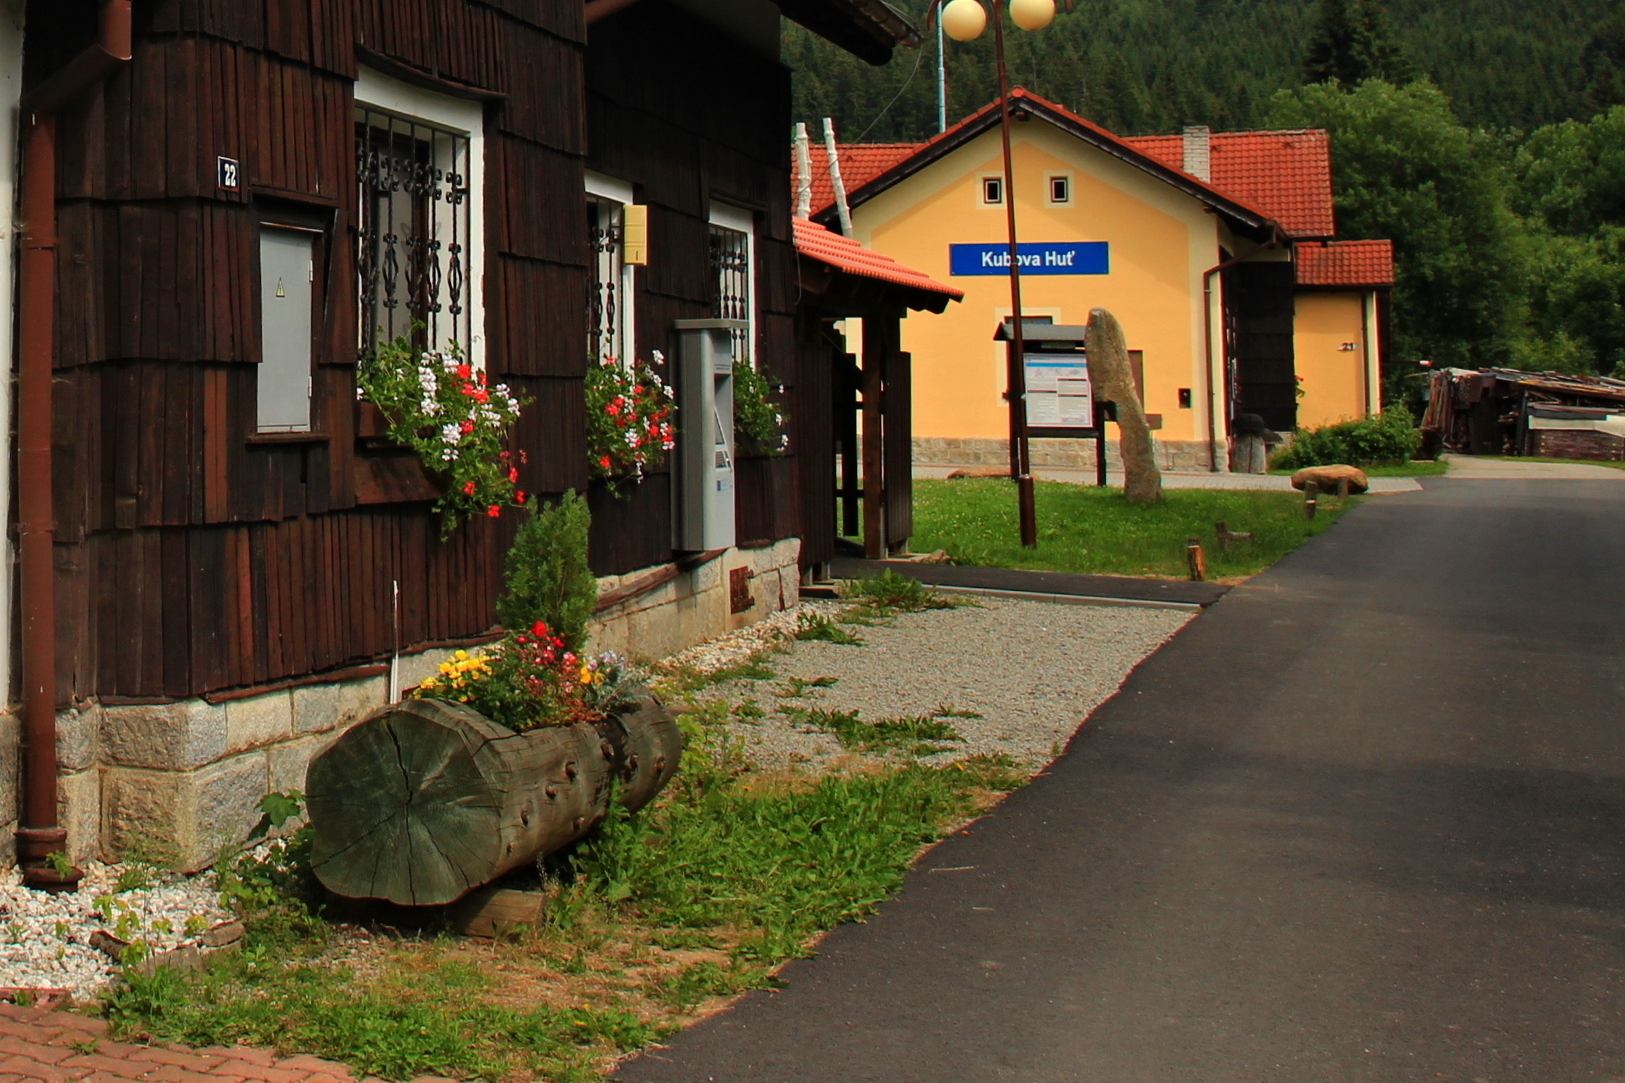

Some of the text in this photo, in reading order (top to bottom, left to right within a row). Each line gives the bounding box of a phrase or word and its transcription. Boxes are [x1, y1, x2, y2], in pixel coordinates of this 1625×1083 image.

[224, 163, 236, 187] 22
[981, 250, 1076, 267] Kubova Huť
